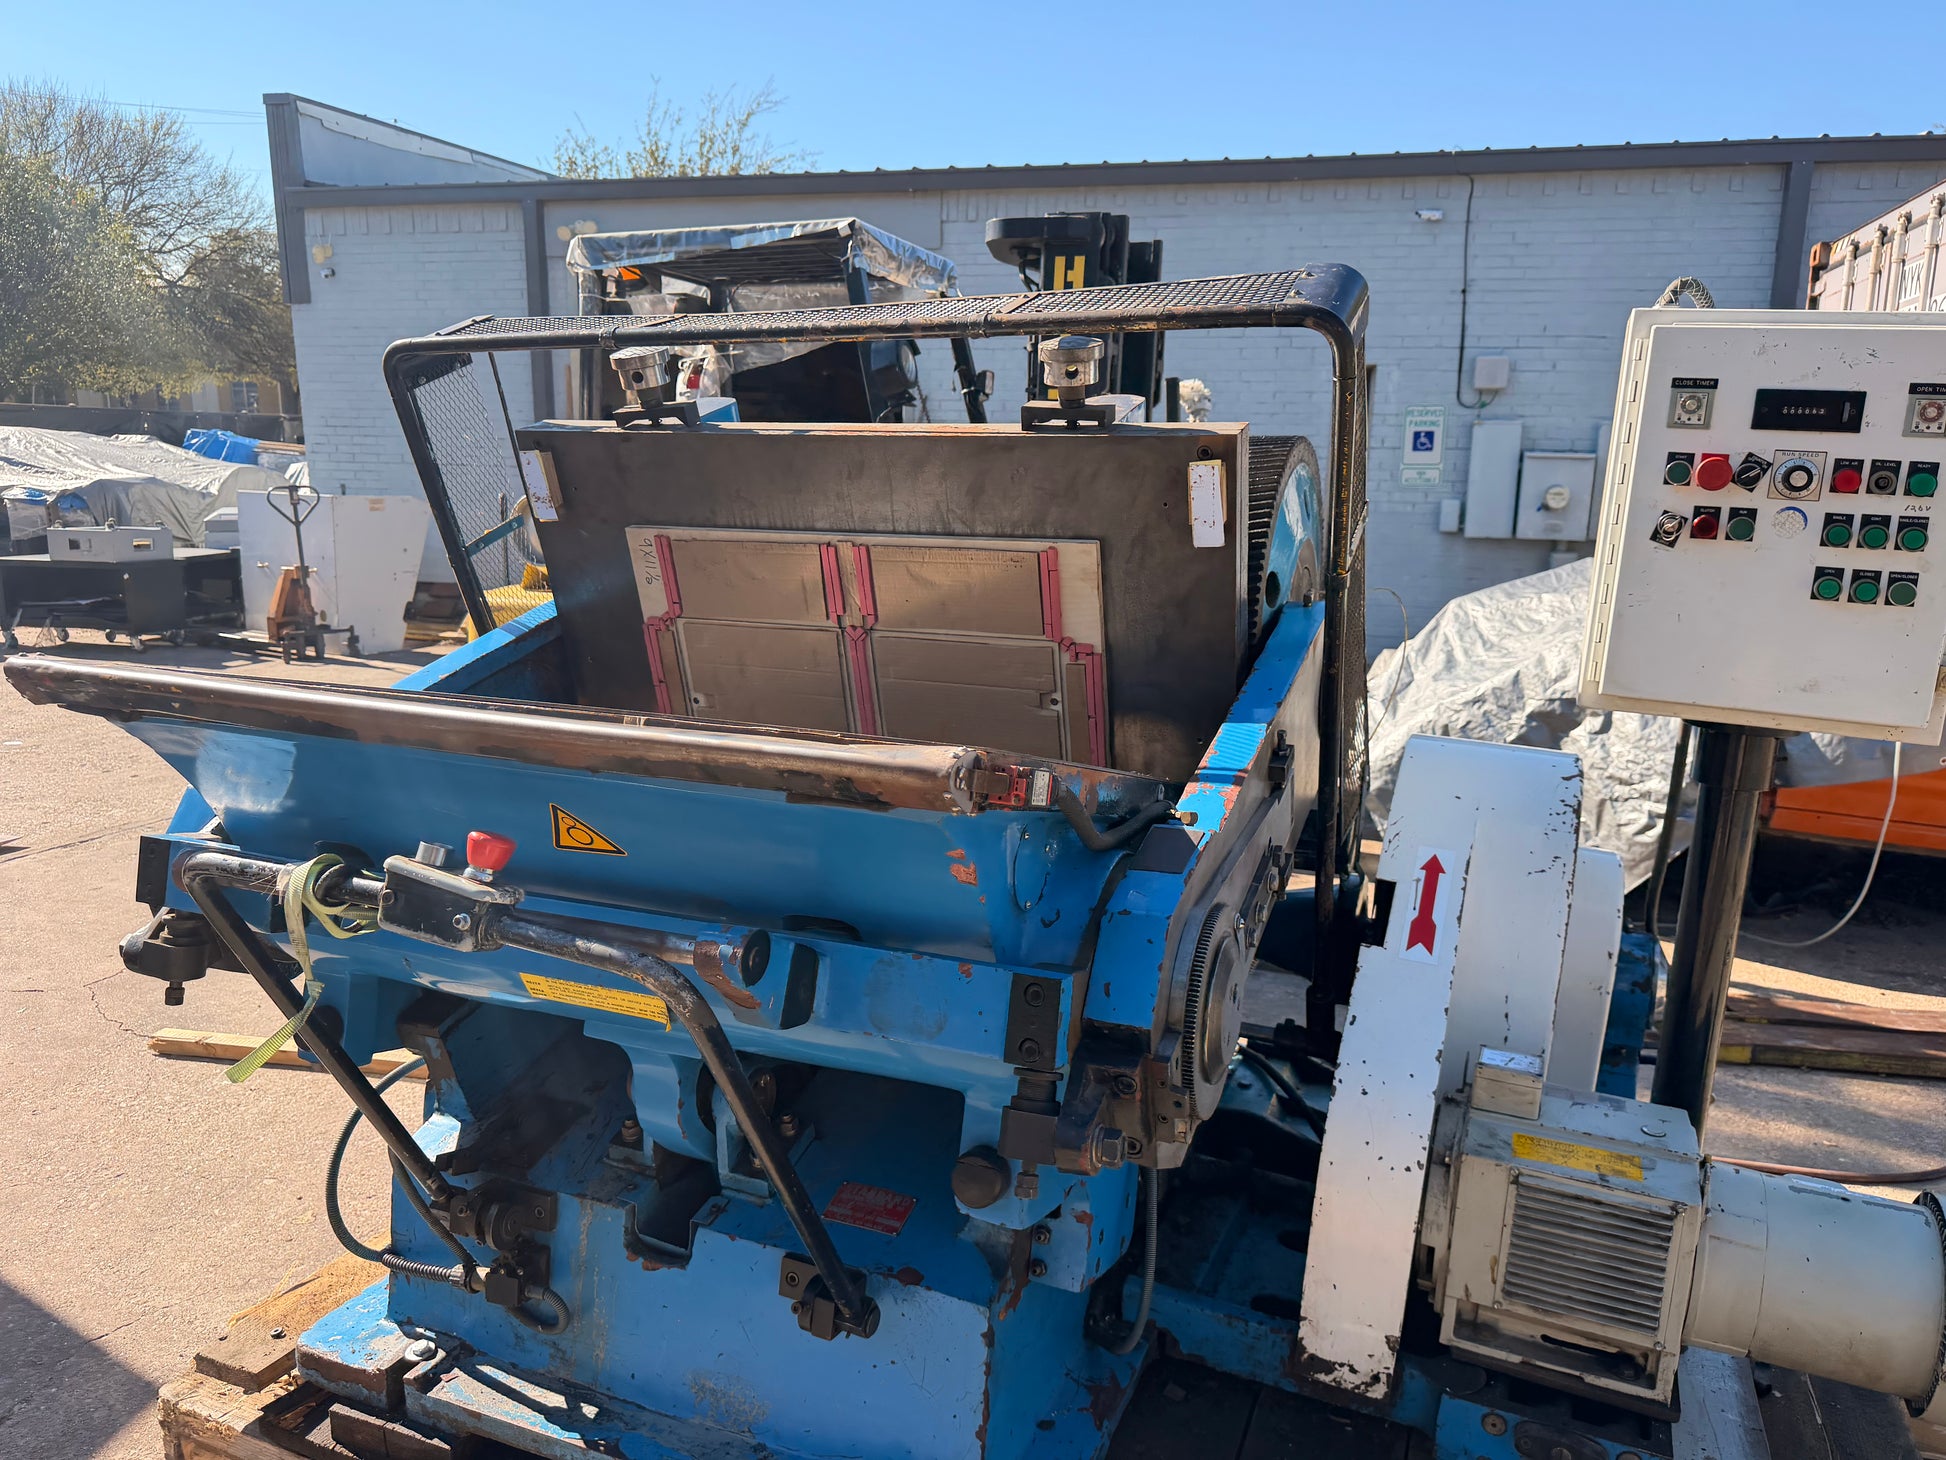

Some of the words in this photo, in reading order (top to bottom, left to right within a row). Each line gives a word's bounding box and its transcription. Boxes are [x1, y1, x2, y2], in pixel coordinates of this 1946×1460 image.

[1053, 256, 1086, 290] H
[1903, 262, 1924, 298] NYK
[1407, 409, 1443, 417] RESERVED
[1409, 419, 1441, 427] PARKING
